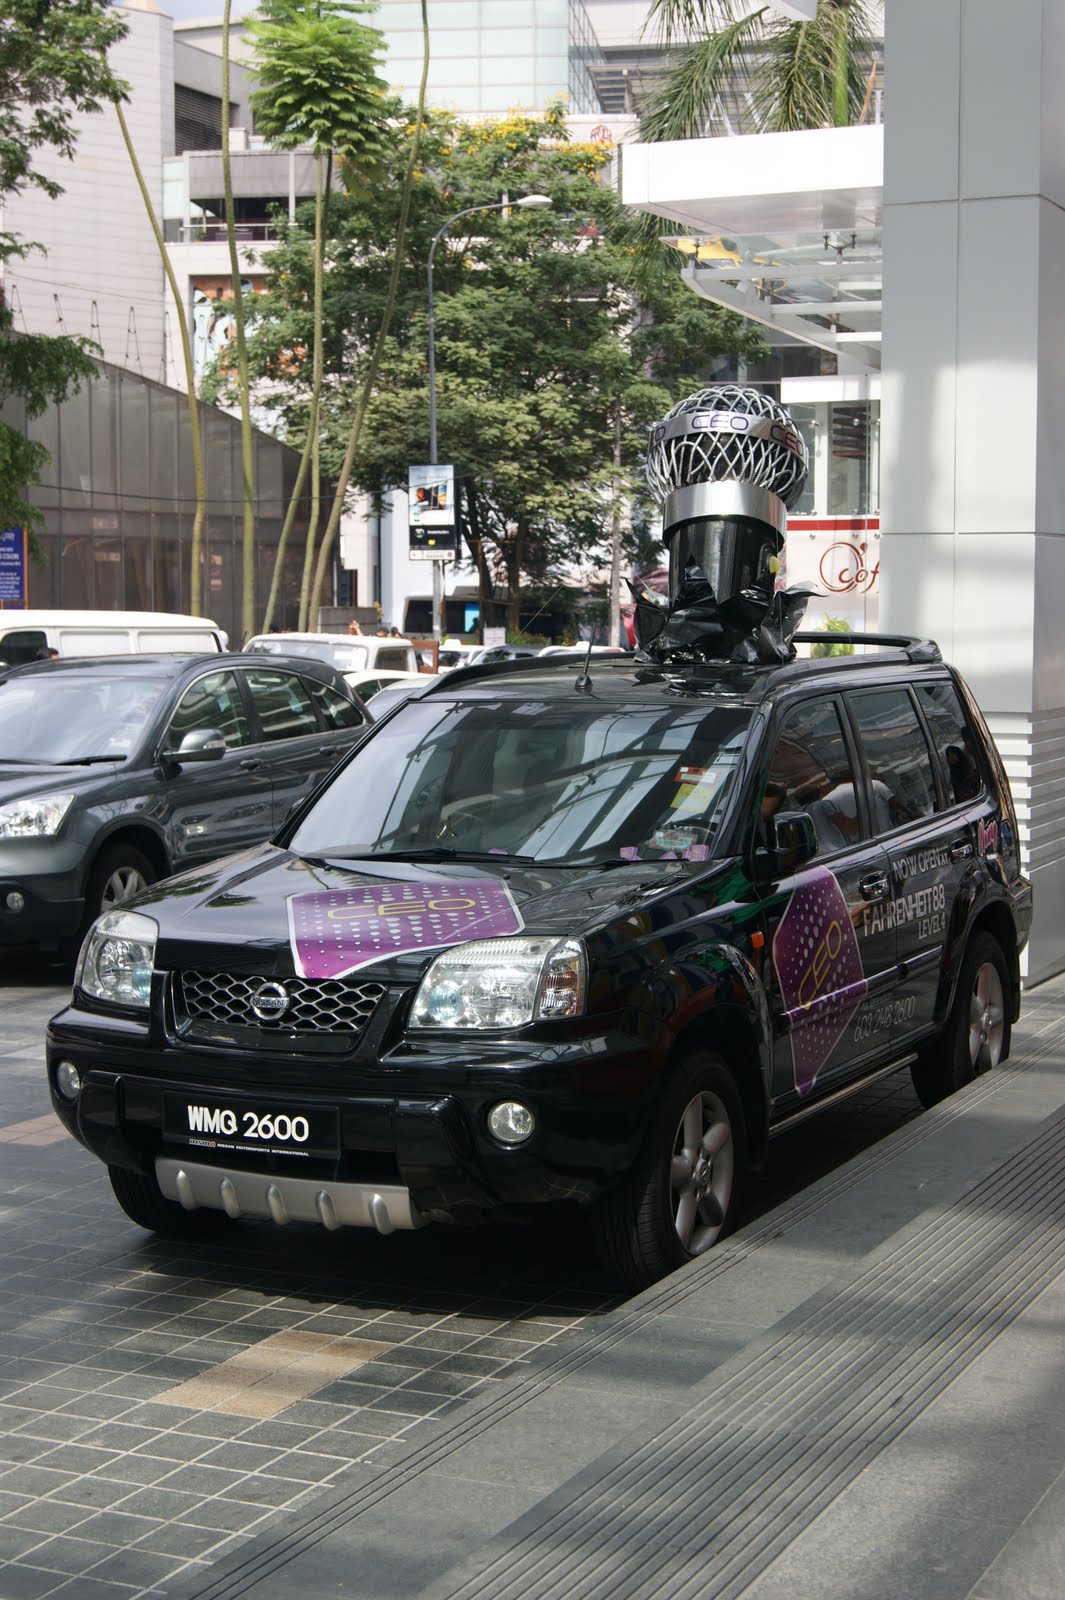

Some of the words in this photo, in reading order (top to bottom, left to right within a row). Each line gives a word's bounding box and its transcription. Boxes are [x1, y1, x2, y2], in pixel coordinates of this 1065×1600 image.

[691, 414, 749, 431] CEO
[770, 424, 804, 457] CEO
[892, 855, 918, 881] NOW
[918, 847, 942, 873] OPEN
[941, 852, 949, 866] AT
[327, 898, 476, 920] CEO
[918, 913, 942, 940] LEVEL
[798, 919, 842, 1011] CEO
[187, 1105, 238, 1135] WMQ
[242, 1112, 310, 1142] 2600
[235, 1145, 271, 1153] MOTORSPORTS
[271, 1149, 310, 1157] INTERNATIONAL
